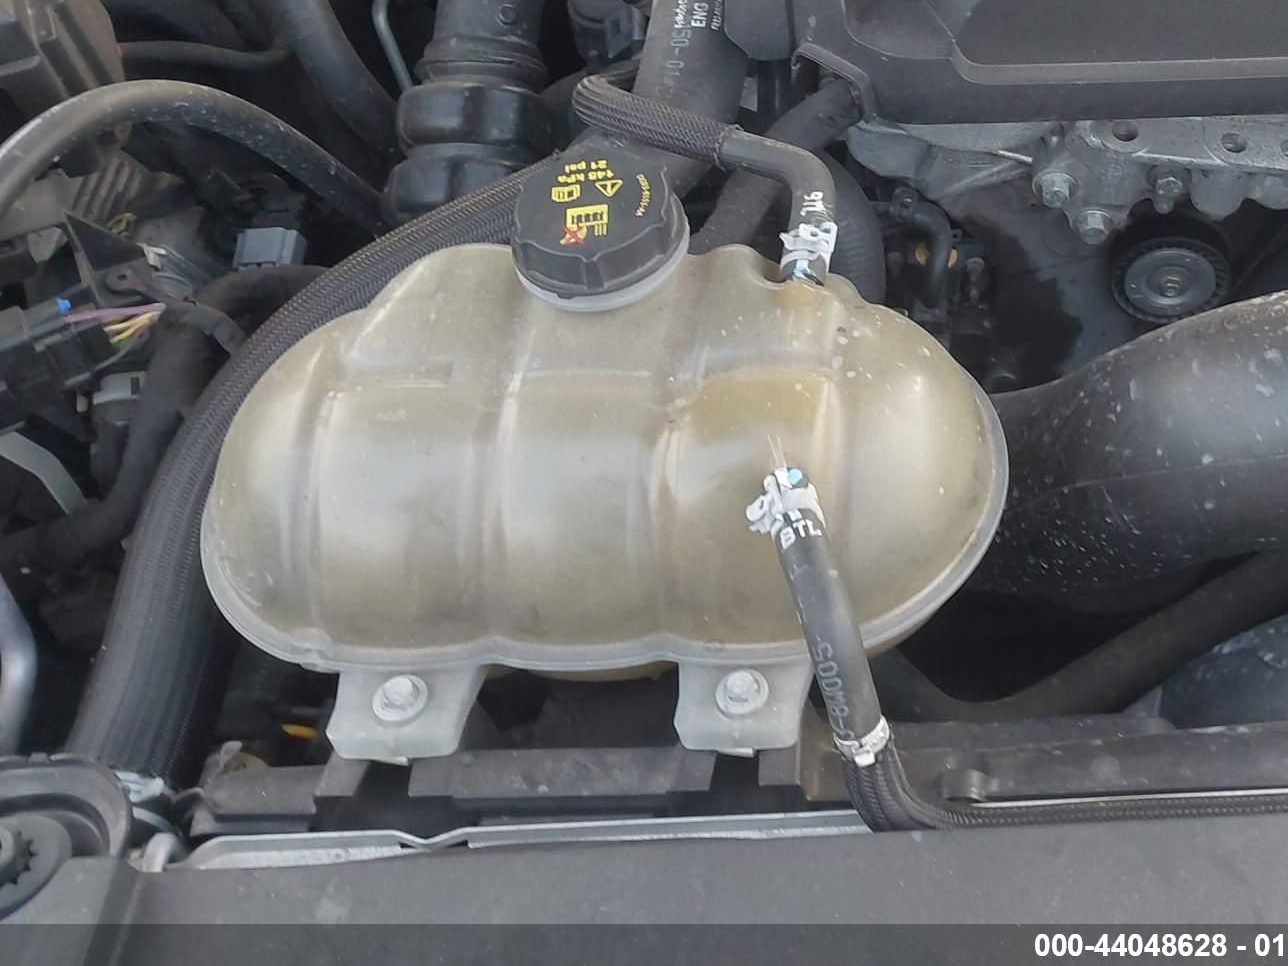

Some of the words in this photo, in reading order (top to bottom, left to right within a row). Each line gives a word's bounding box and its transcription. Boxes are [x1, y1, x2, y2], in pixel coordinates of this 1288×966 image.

[690, 2, 709, 28] ENG
[564, 160, 587, 174] psi
[590, 159, 608, 170] 21
[557, 172, 585, 184] kPa
[779, 519, 823, 551] BTL
